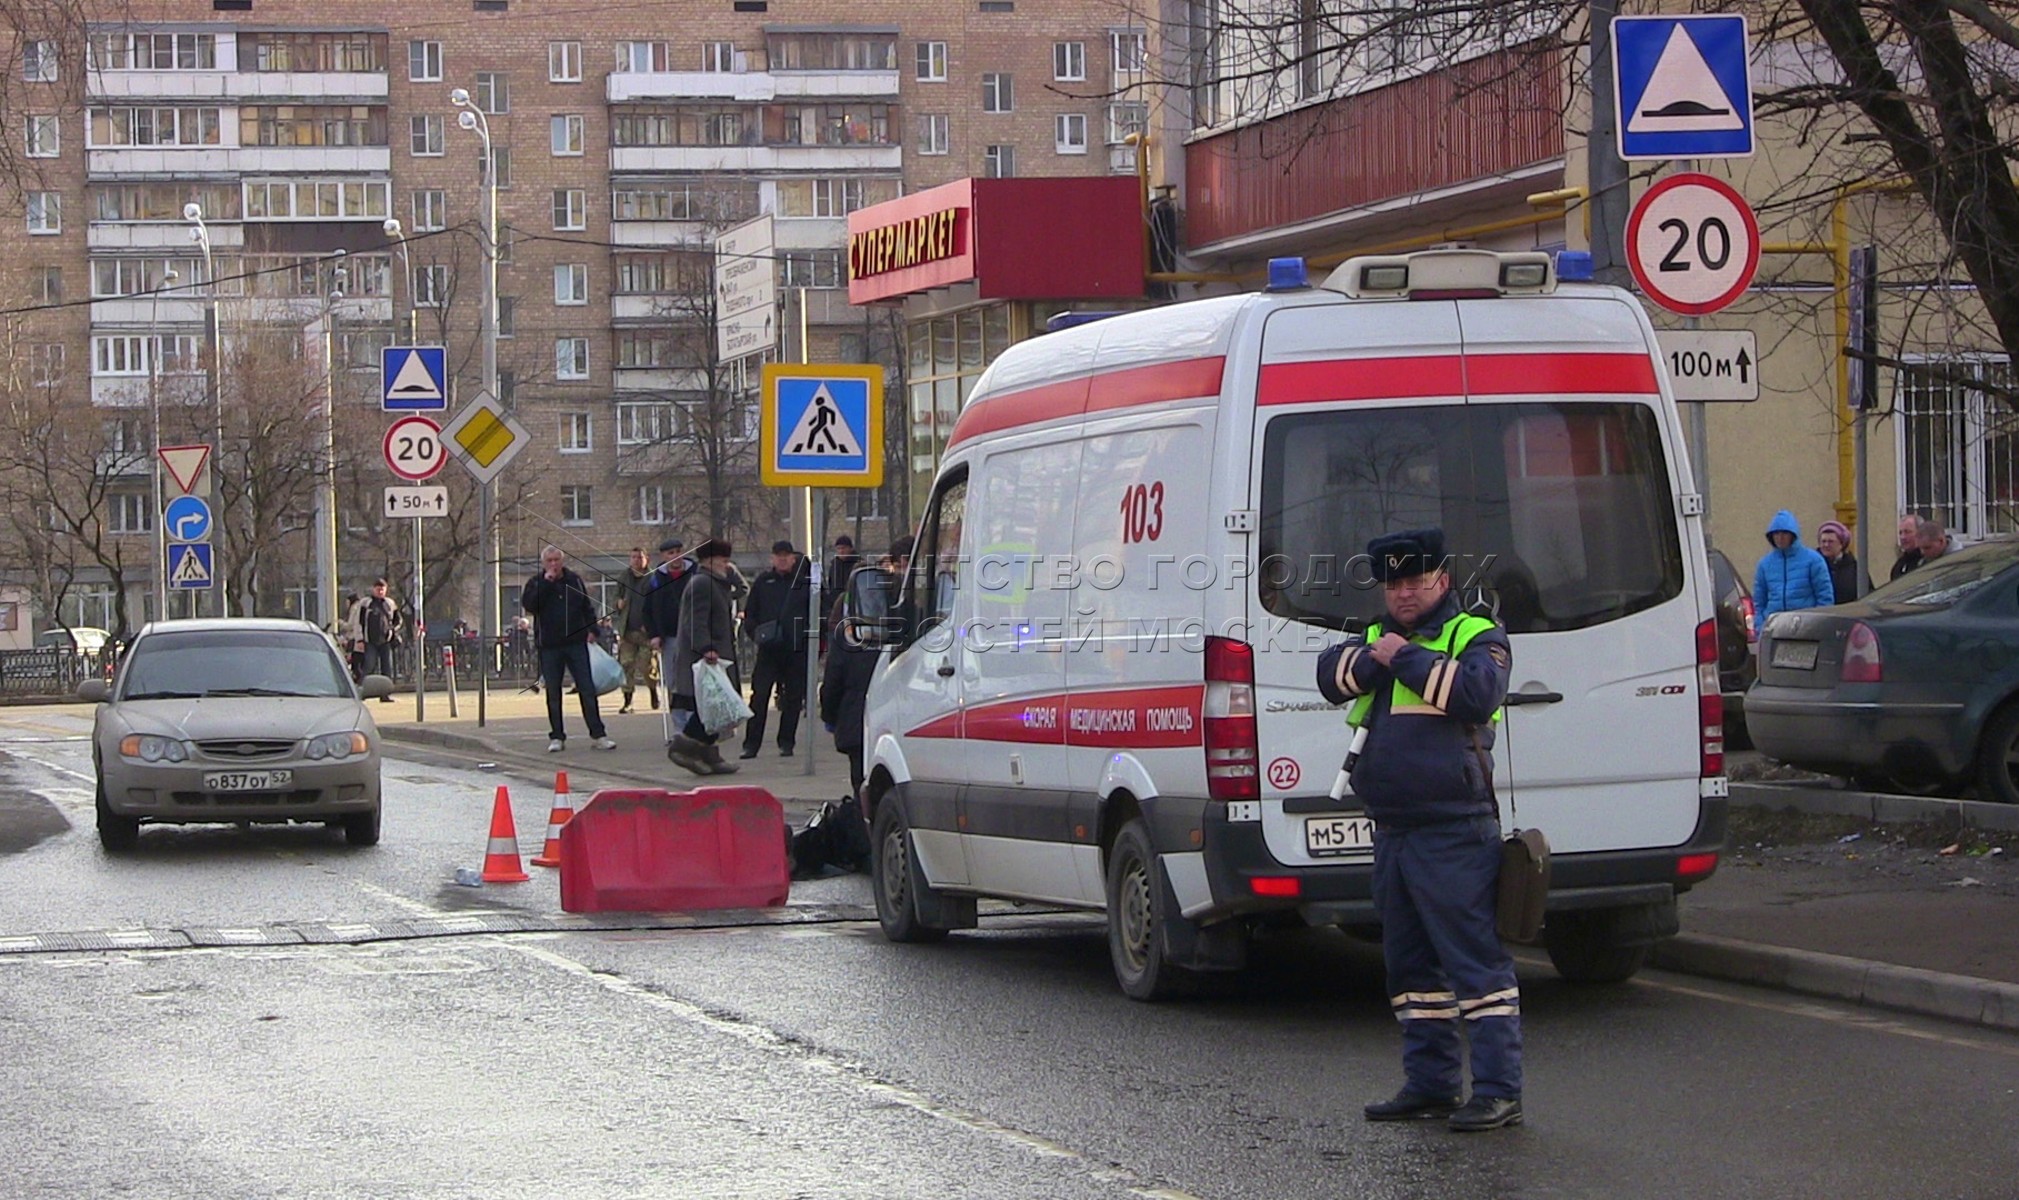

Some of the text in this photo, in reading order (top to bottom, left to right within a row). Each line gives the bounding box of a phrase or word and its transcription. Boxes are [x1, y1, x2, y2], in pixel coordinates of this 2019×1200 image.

[850, 207, 957, 280] СУПЕРМАРКЕТ
[1658, 216, 1731, 272] 20
[398, 436, 433, 461] 20
[1120, 480, 1164, 545] 103
[1023, 706, 1193, 735] СКОРАЯ МЕДИЦИНСКАЯ ПОМОЩЬ
[271, 772, 287, 783] 52
[1273, 764, 1296, 784] 22
